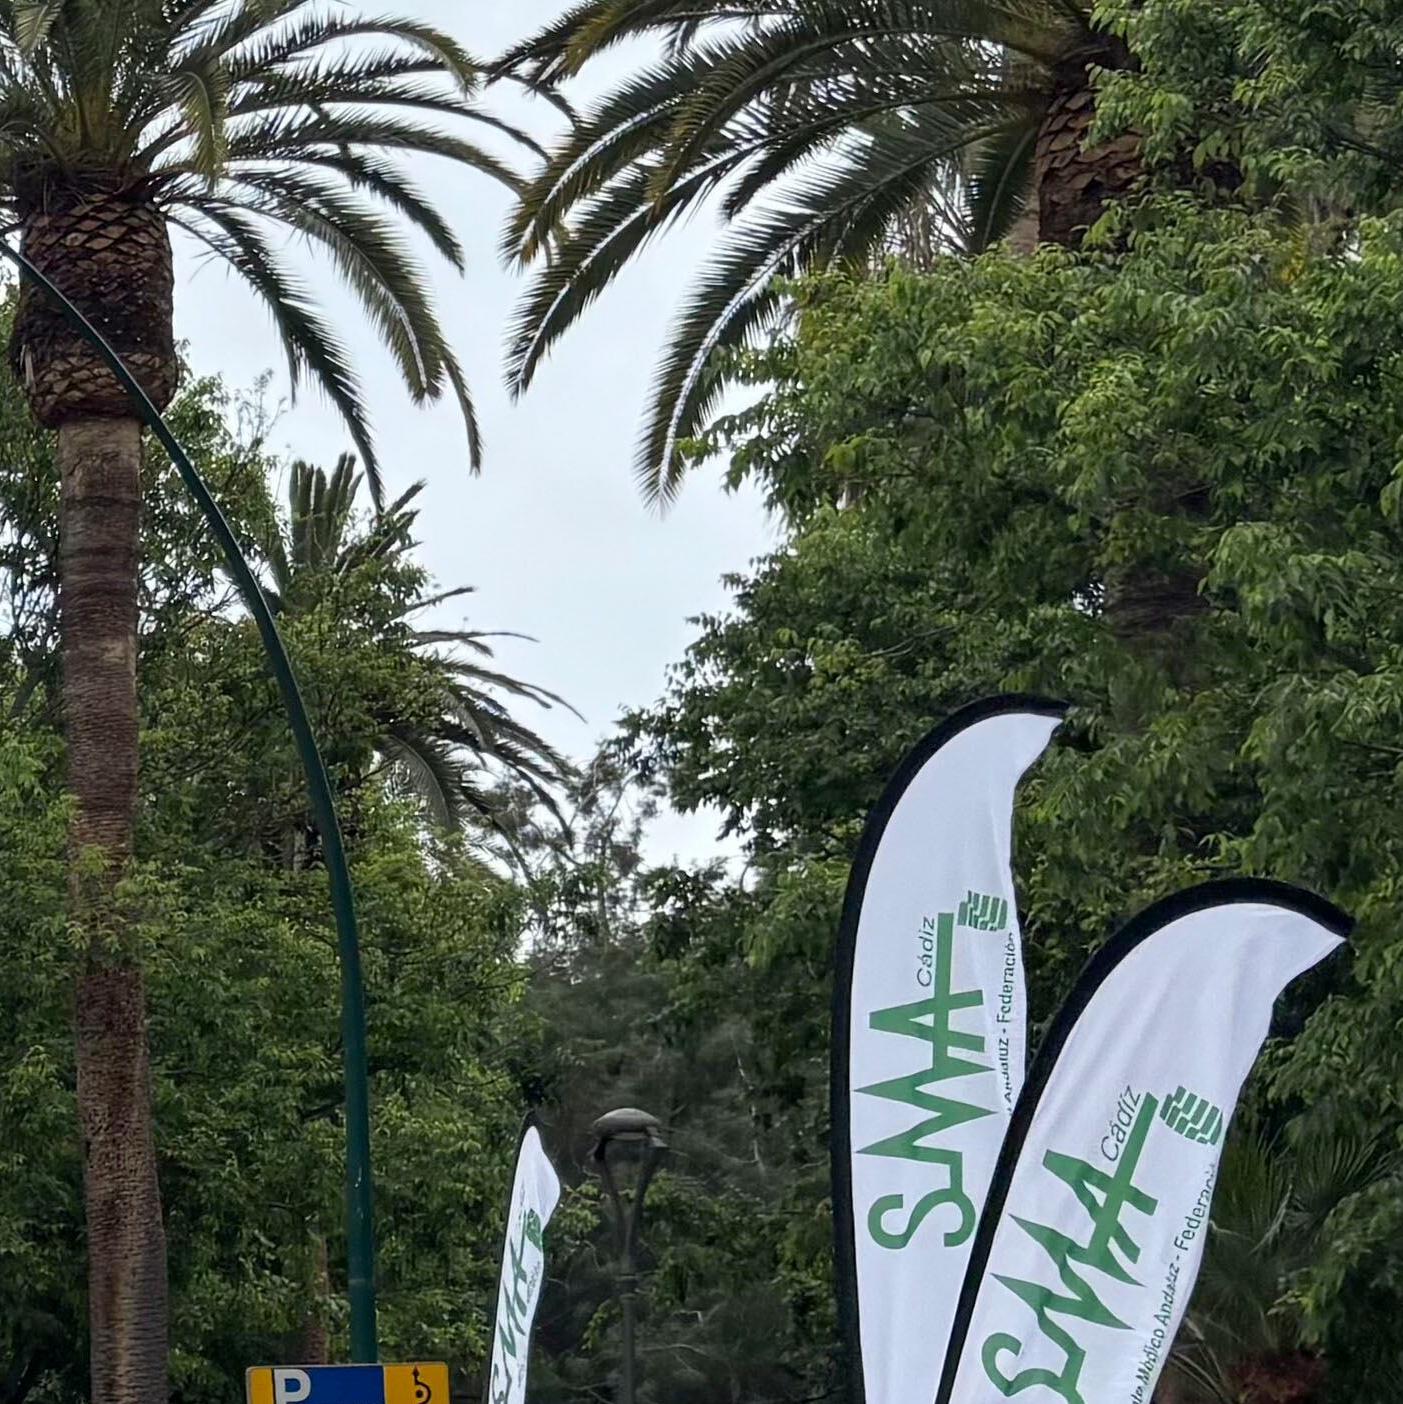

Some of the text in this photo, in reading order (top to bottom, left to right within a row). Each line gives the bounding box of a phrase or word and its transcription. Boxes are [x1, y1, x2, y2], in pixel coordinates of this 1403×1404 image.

[916, 916, 935, 988] Cádiz
[852, 912, 999, 1250] SMA
[1100, 1084, 1142, 1163] Cádiz
